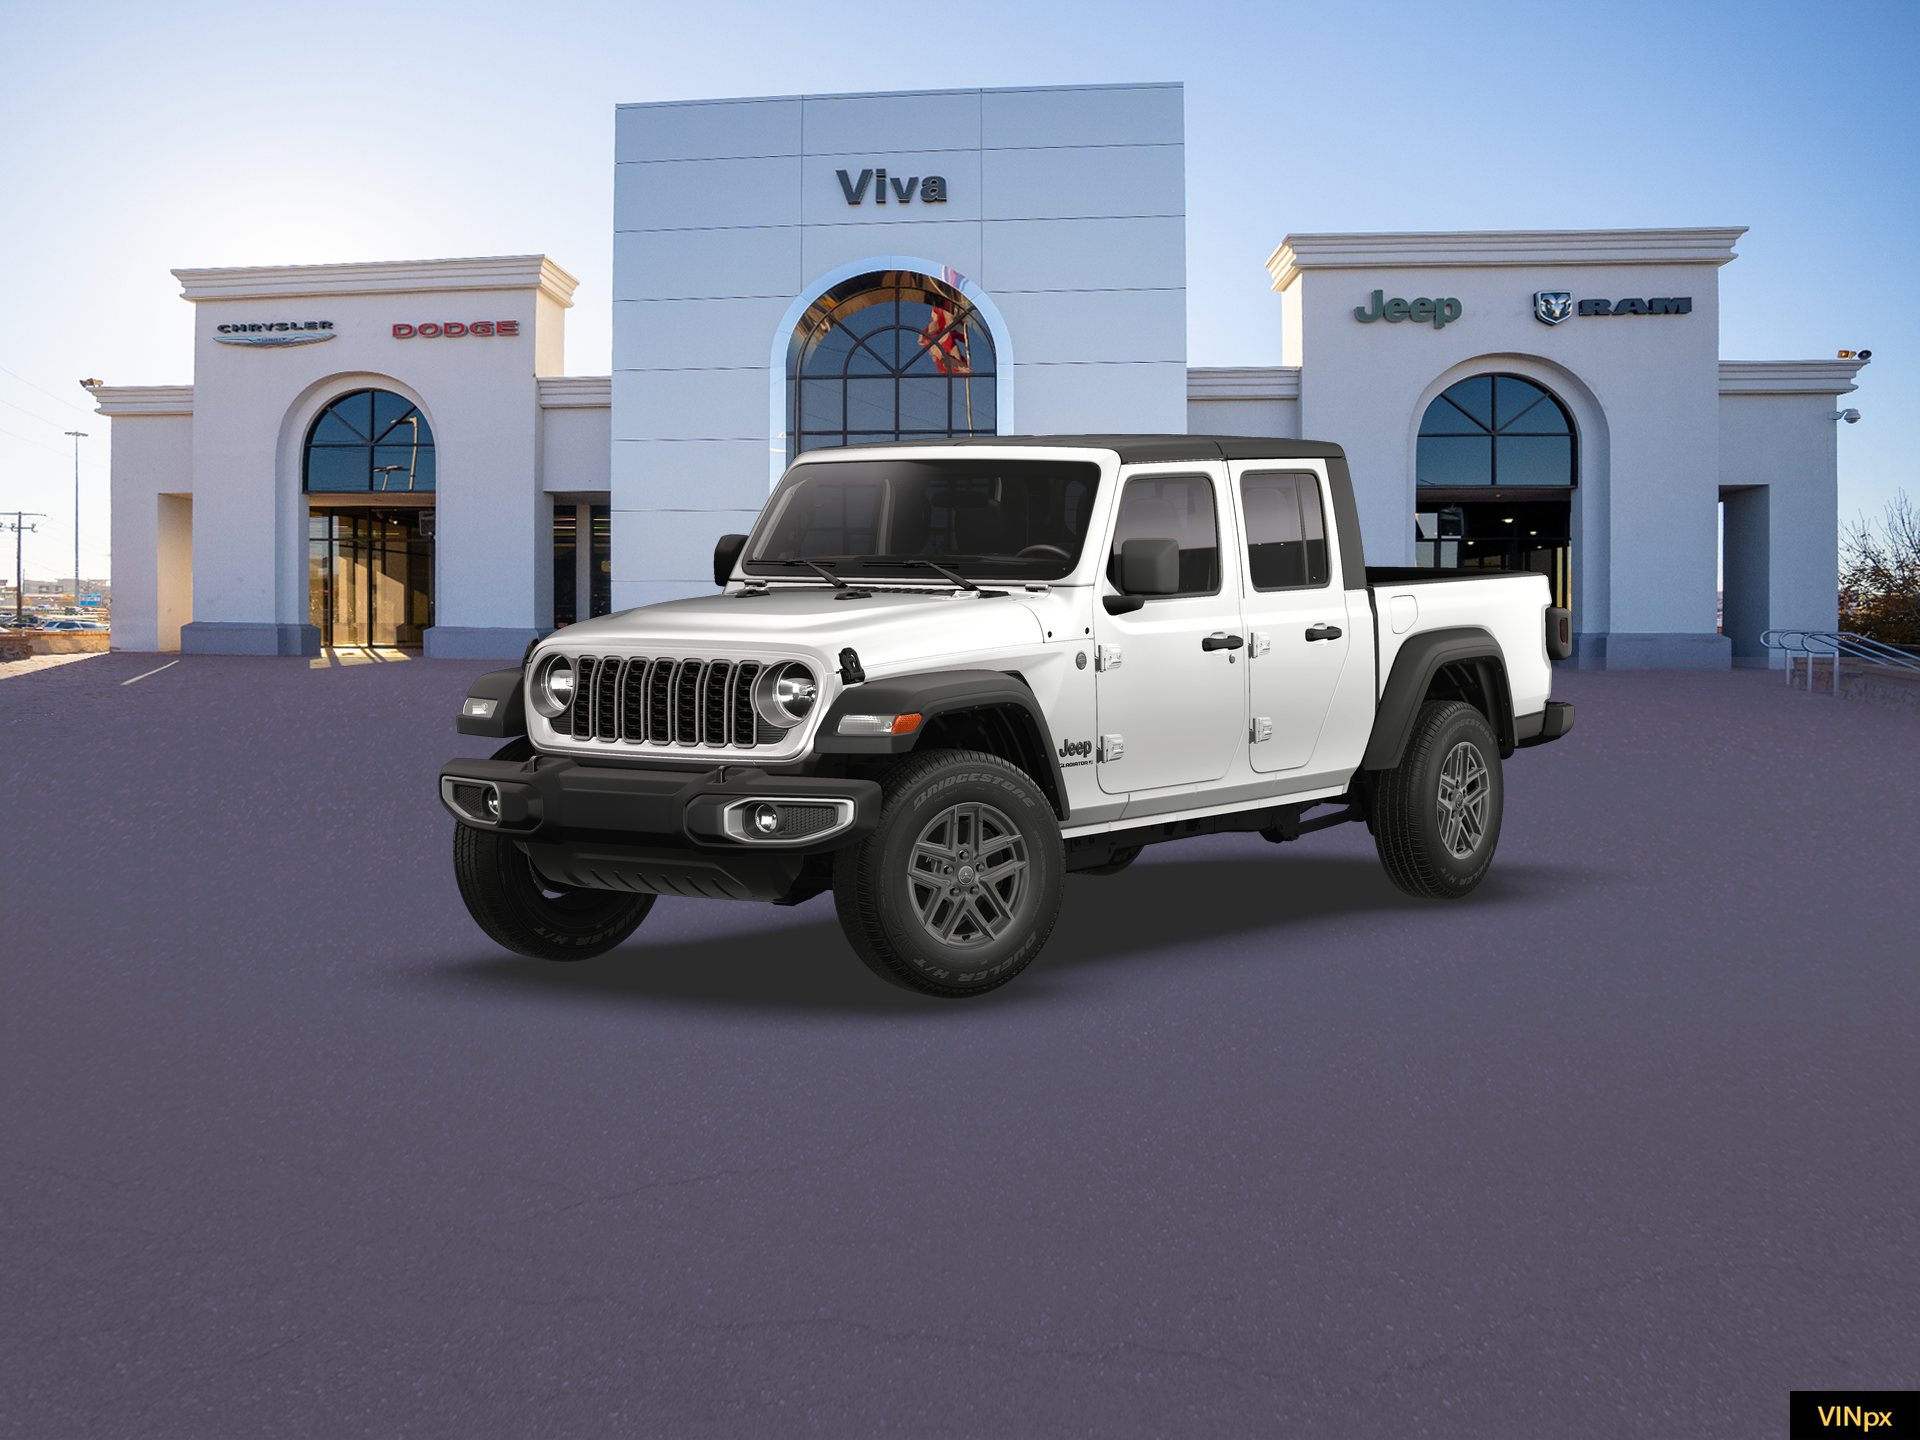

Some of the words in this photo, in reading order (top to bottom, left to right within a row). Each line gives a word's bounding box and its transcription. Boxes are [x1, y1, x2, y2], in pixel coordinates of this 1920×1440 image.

[835, 168, 947, 205] Viva
[1354, 289, 1463, 330] Jeep
[1578, 297, 1692, 316] RAM
[217, 321, 334, 333] CHRYSLER
[392, 320, 519, 339] DODGE
[1059, 738, 1092, 758] Jeep
[913, 773, 1036, 812] BRIDGESTONE
[957, 930, 1037, 982] DUELER
[912, 957, 950, 980] H/T
